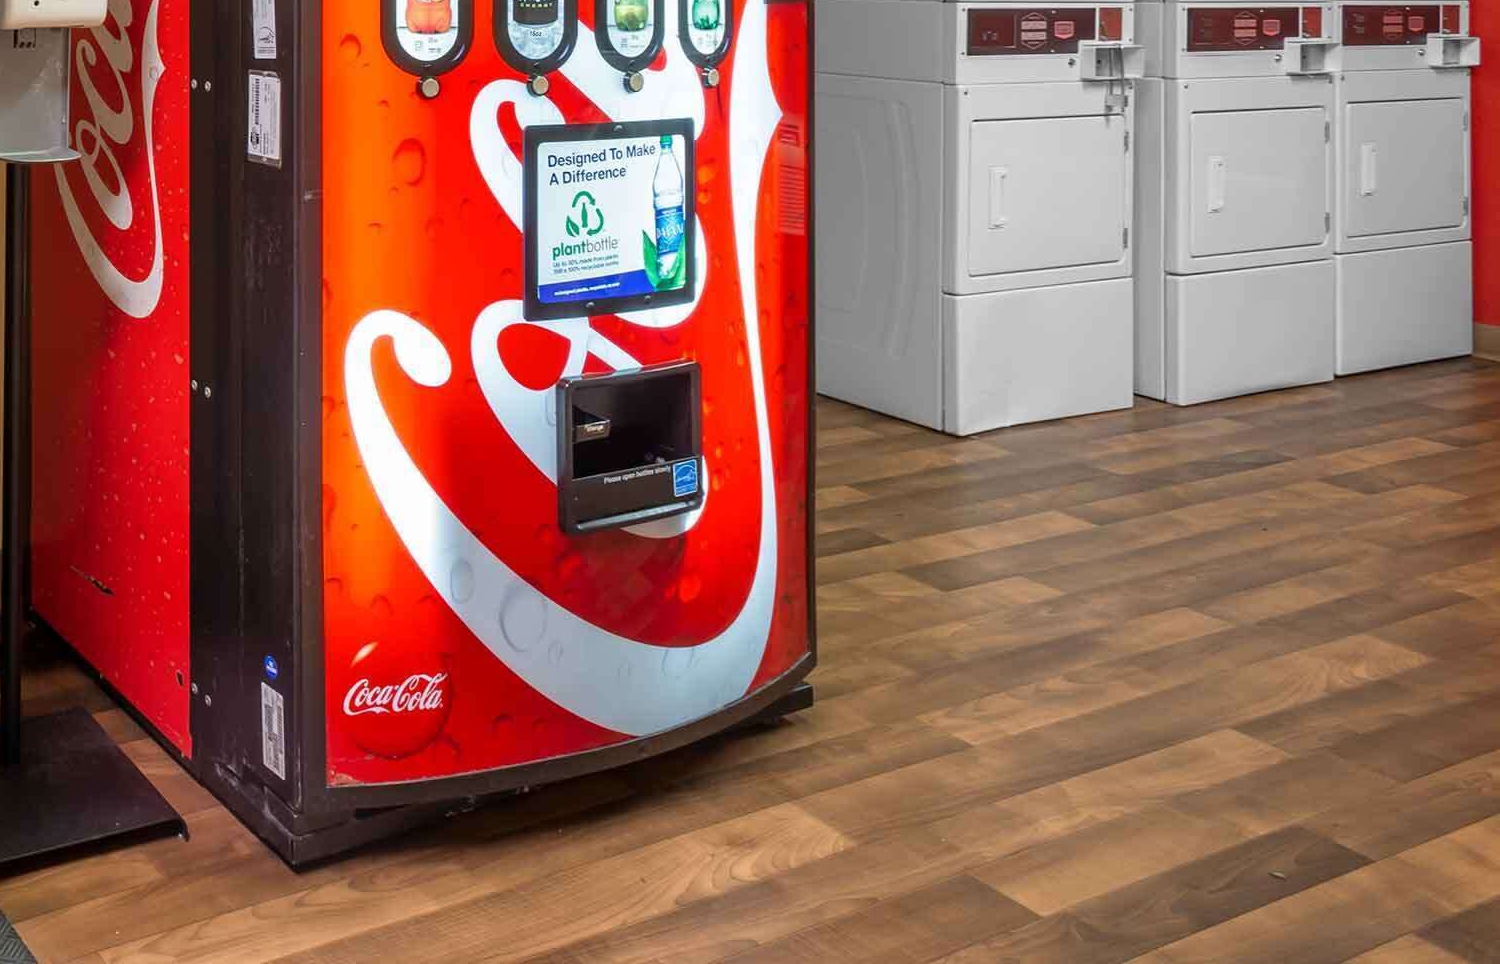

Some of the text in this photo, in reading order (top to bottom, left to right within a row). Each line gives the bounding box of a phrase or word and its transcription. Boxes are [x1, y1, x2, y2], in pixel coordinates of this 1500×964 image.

[547, 143, 656, 168] Designed To Make
[549, 166, 627, 186] A Difference
[552, 235, 619, 261] plantbottle
[603, 475, 621, 484] Please
[342, 672, 448, 716] Coca-Cola
